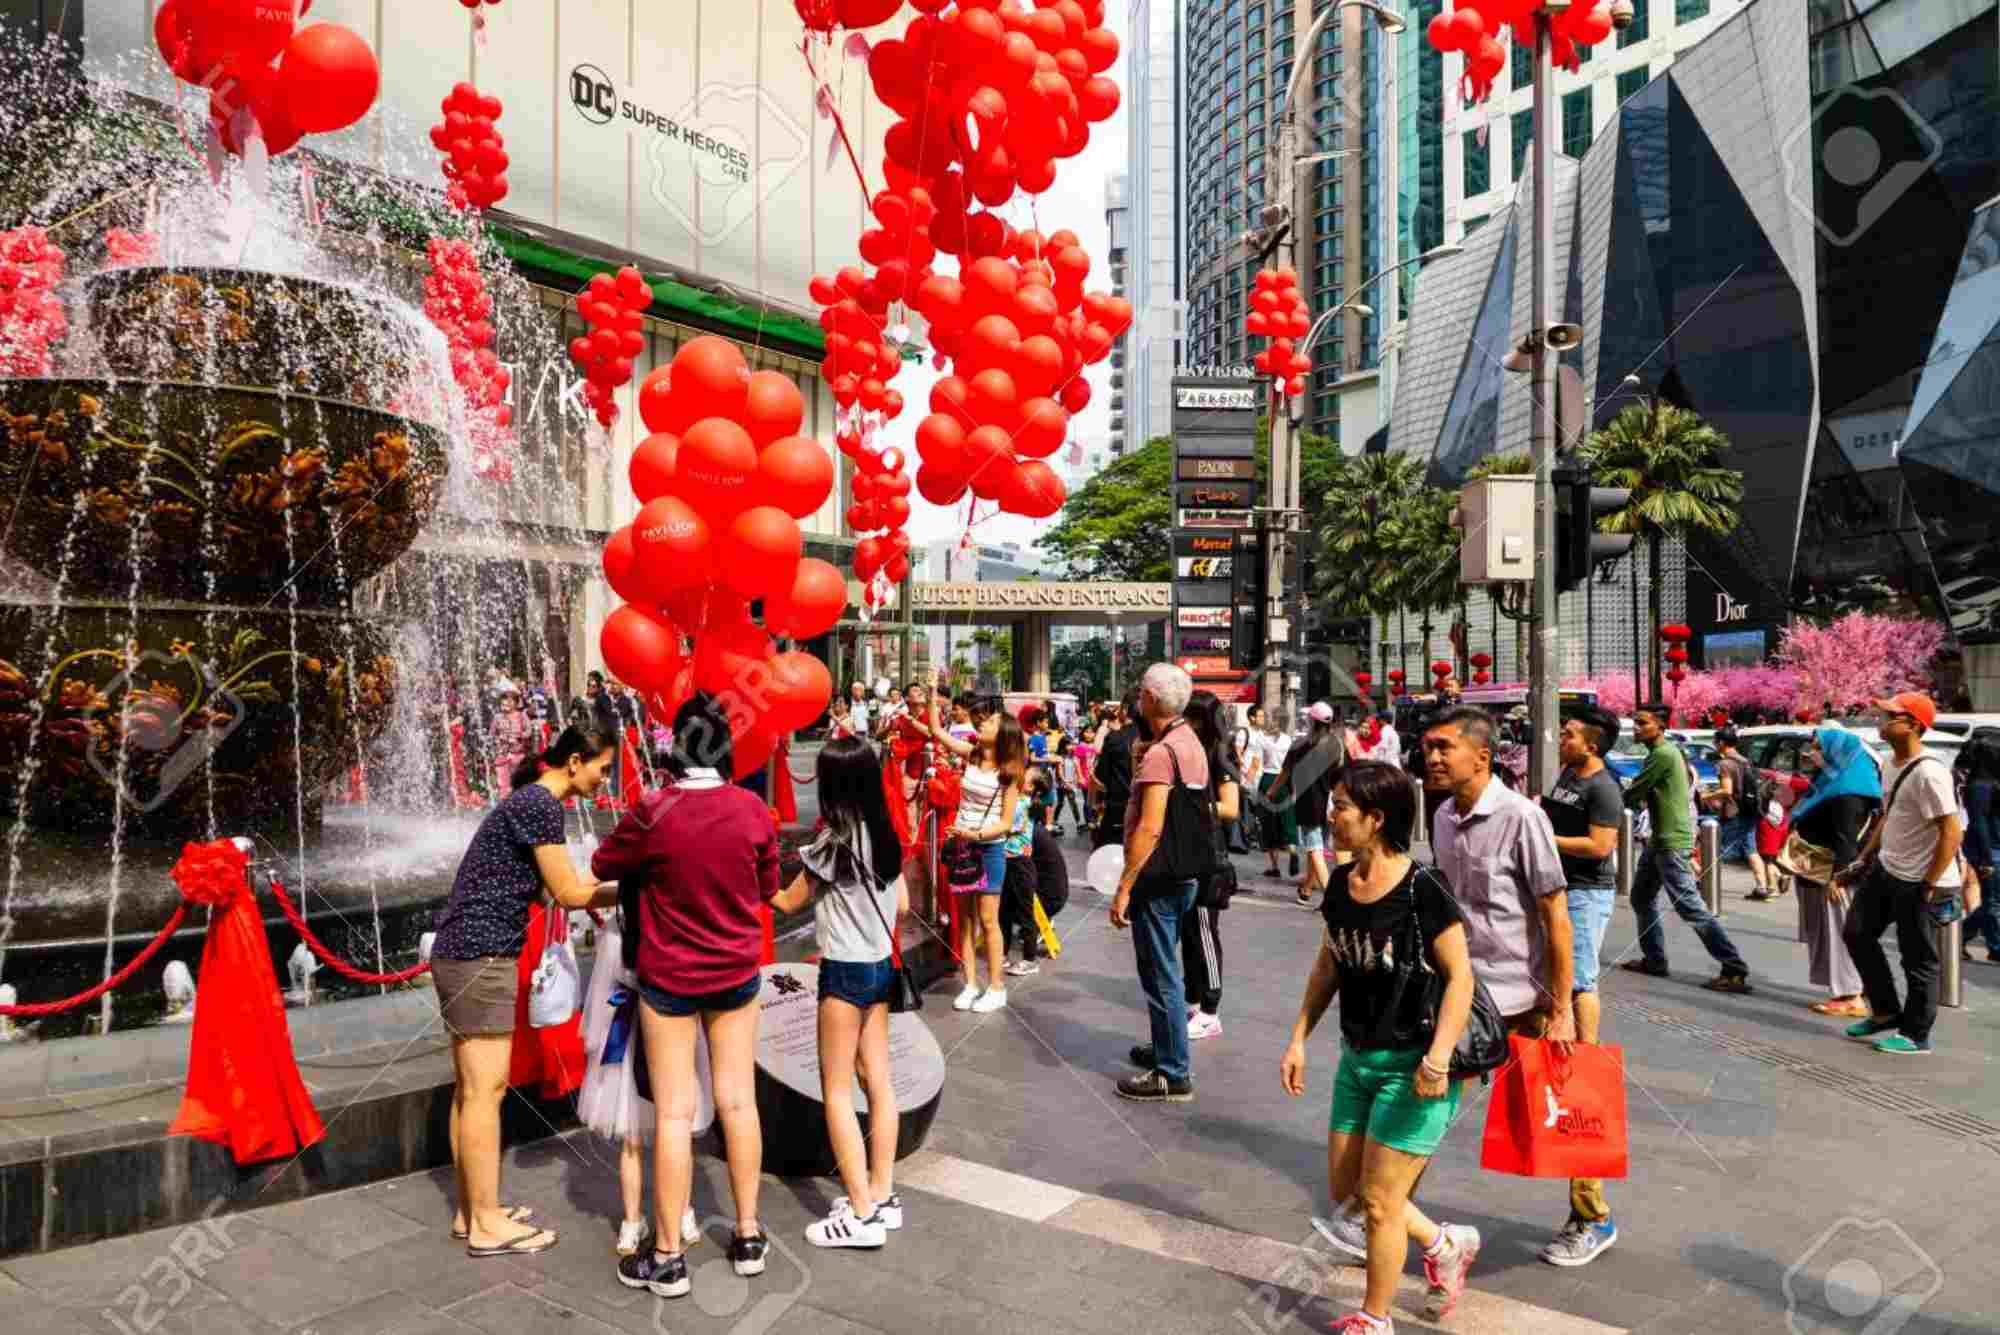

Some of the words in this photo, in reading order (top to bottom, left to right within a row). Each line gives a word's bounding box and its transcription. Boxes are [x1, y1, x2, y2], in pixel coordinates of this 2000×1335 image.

[571, 71, 614, 118] DC
[621, 100, 679, 139] SUPER
[683, 128, 749, 169] HEROES
[911, 587, 970, 606] BUKIT
[976, 587, 1065, 606] BINTANG
[1715, 592, 1750, 623] Dior
